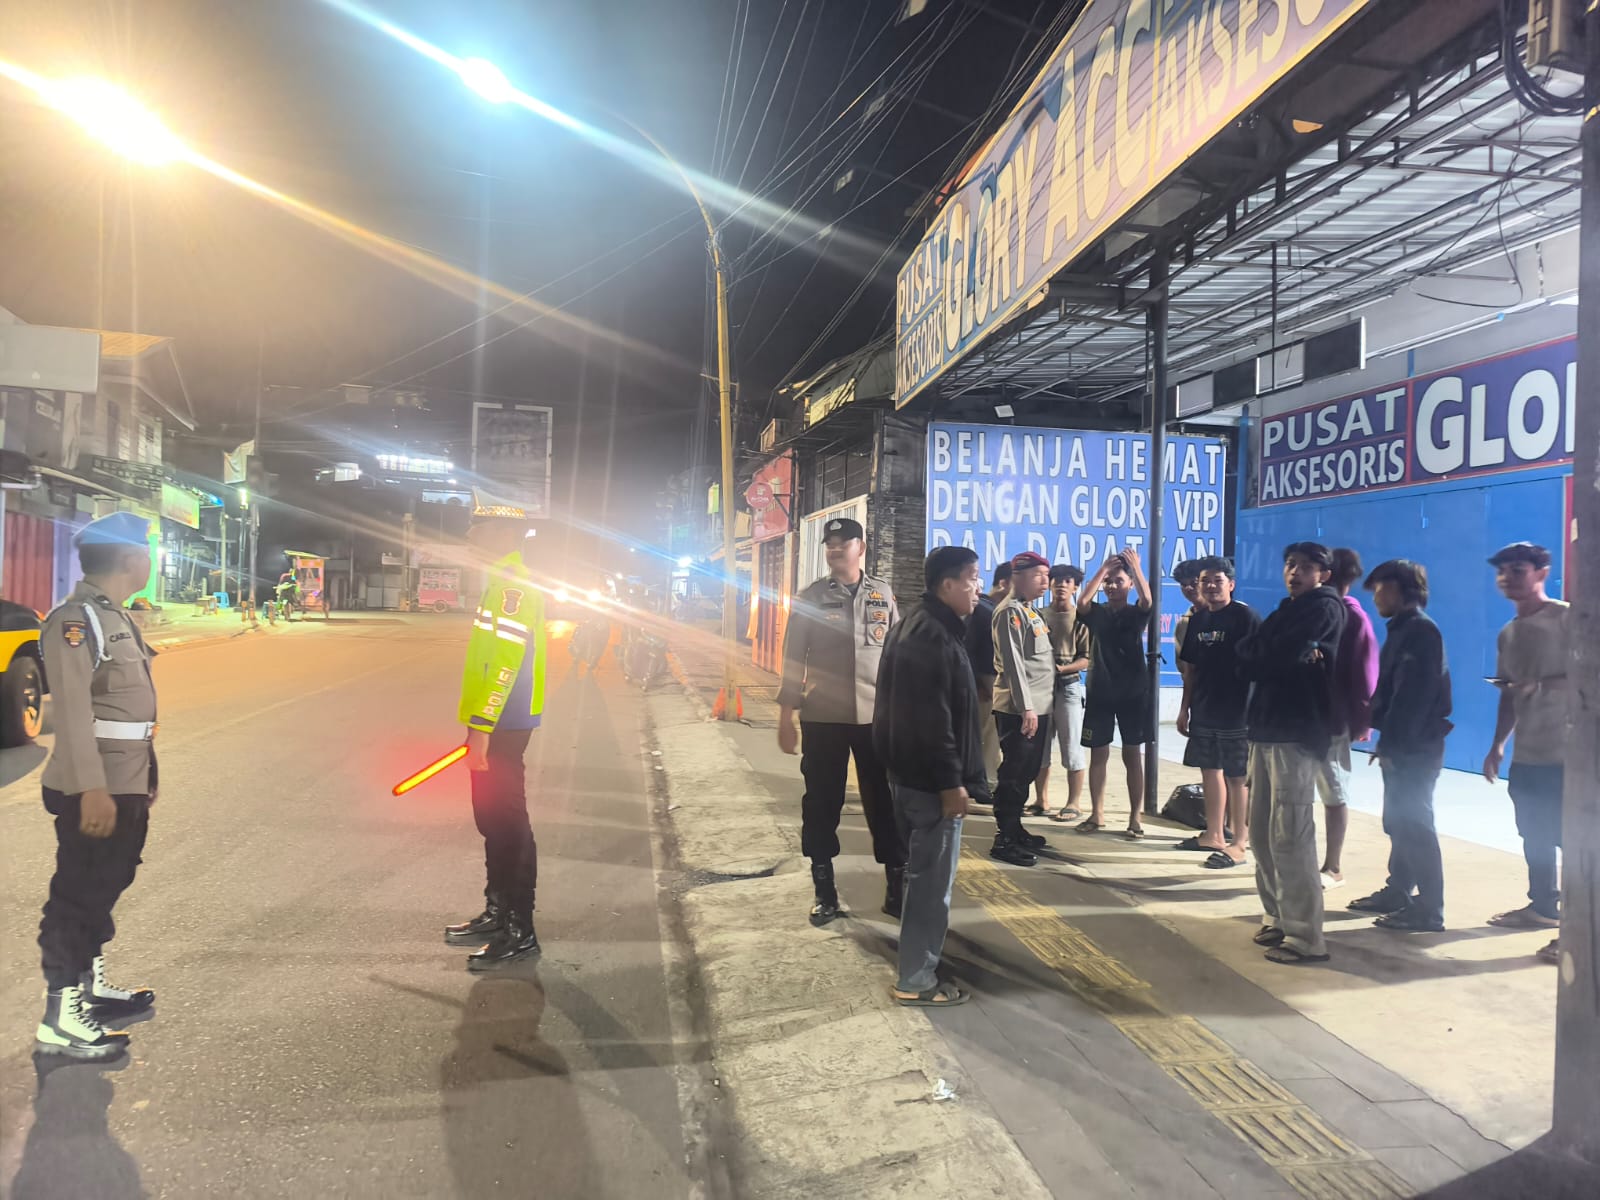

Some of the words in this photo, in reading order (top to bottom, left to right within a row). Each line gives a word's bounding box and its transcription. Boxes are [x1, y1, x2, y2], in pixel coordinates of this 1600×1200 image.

[945, 122, 1040, 352] GLORY
[1043, 0, 1151, 265] ACC
[898, 221, 946, 336] PUSAT
[898, 301, 944, 395] AKSESORIS
[933, 430, 1088, 479] BELANJA
[1263, 387, 1406, 458] PUSAT
[932, 479, 1059, 526] DENGAN
[1070, 485, 1151, 530] GLOR
[1172, 490, 1219, 532] VIP
[1261, 439, 1405, 501] AKSESORIS
